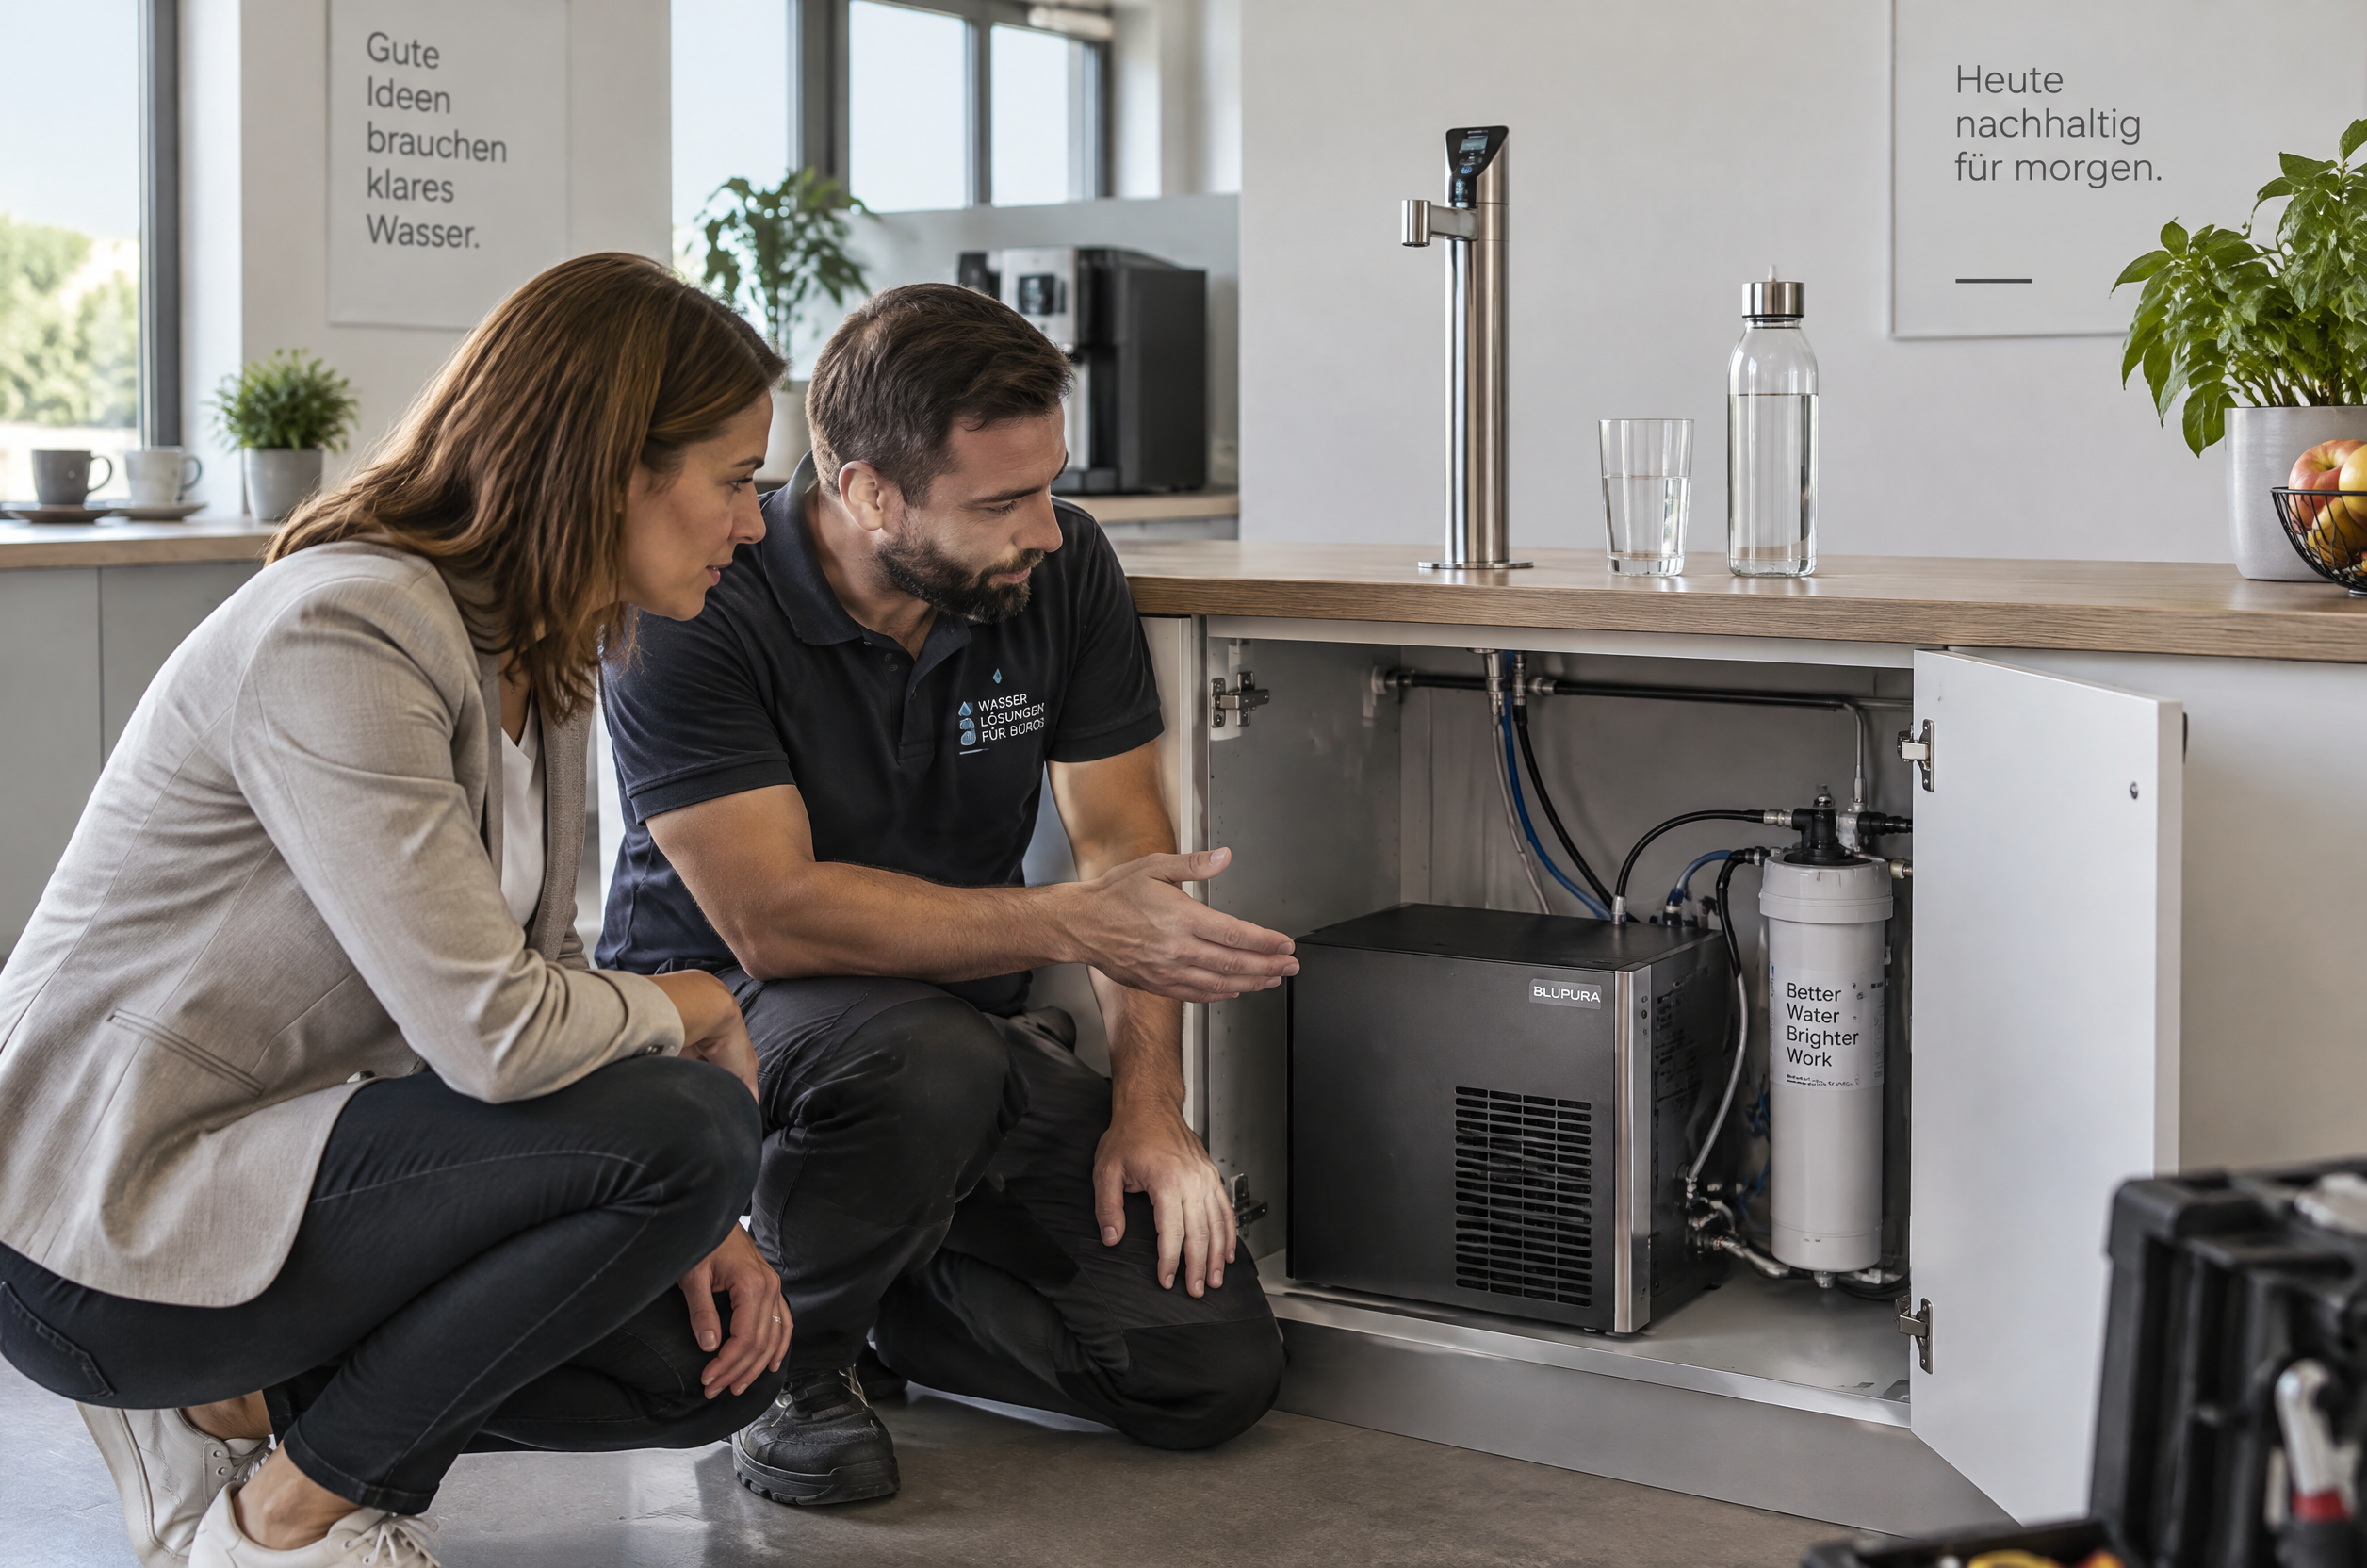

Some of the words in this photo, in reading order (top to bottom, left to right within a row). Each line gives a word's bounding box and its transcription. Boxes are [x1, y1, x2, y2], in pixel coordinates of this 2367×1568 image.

[367, 31, 440, 70] Gute
[1957, 64, 2064, 94] Heute
[367, 75, 450, 114] Ideen
[367, 120, 507, 163] brauchen
[1956, 107, 2141, 146] nachhaltig
[367, 166, 454, 204] klares
[1954, 151, 2003, 182] für
[2016, 158, 2163, 189] morgen.
[366, 213, 480, 249] Wasser.
[978, 694, 1028, 711] WASSER
[982, 727, 1007, 743] FÜR
[1533, 986, 1600, 1003] BLUPURA
[1787, 982, 1842, 1002] Better
[1787, 1002, 1840, 1024] Water
[1787, 1024, 1860, 1050] Brighter
[1787, 1046, 1833, 1068] Work
